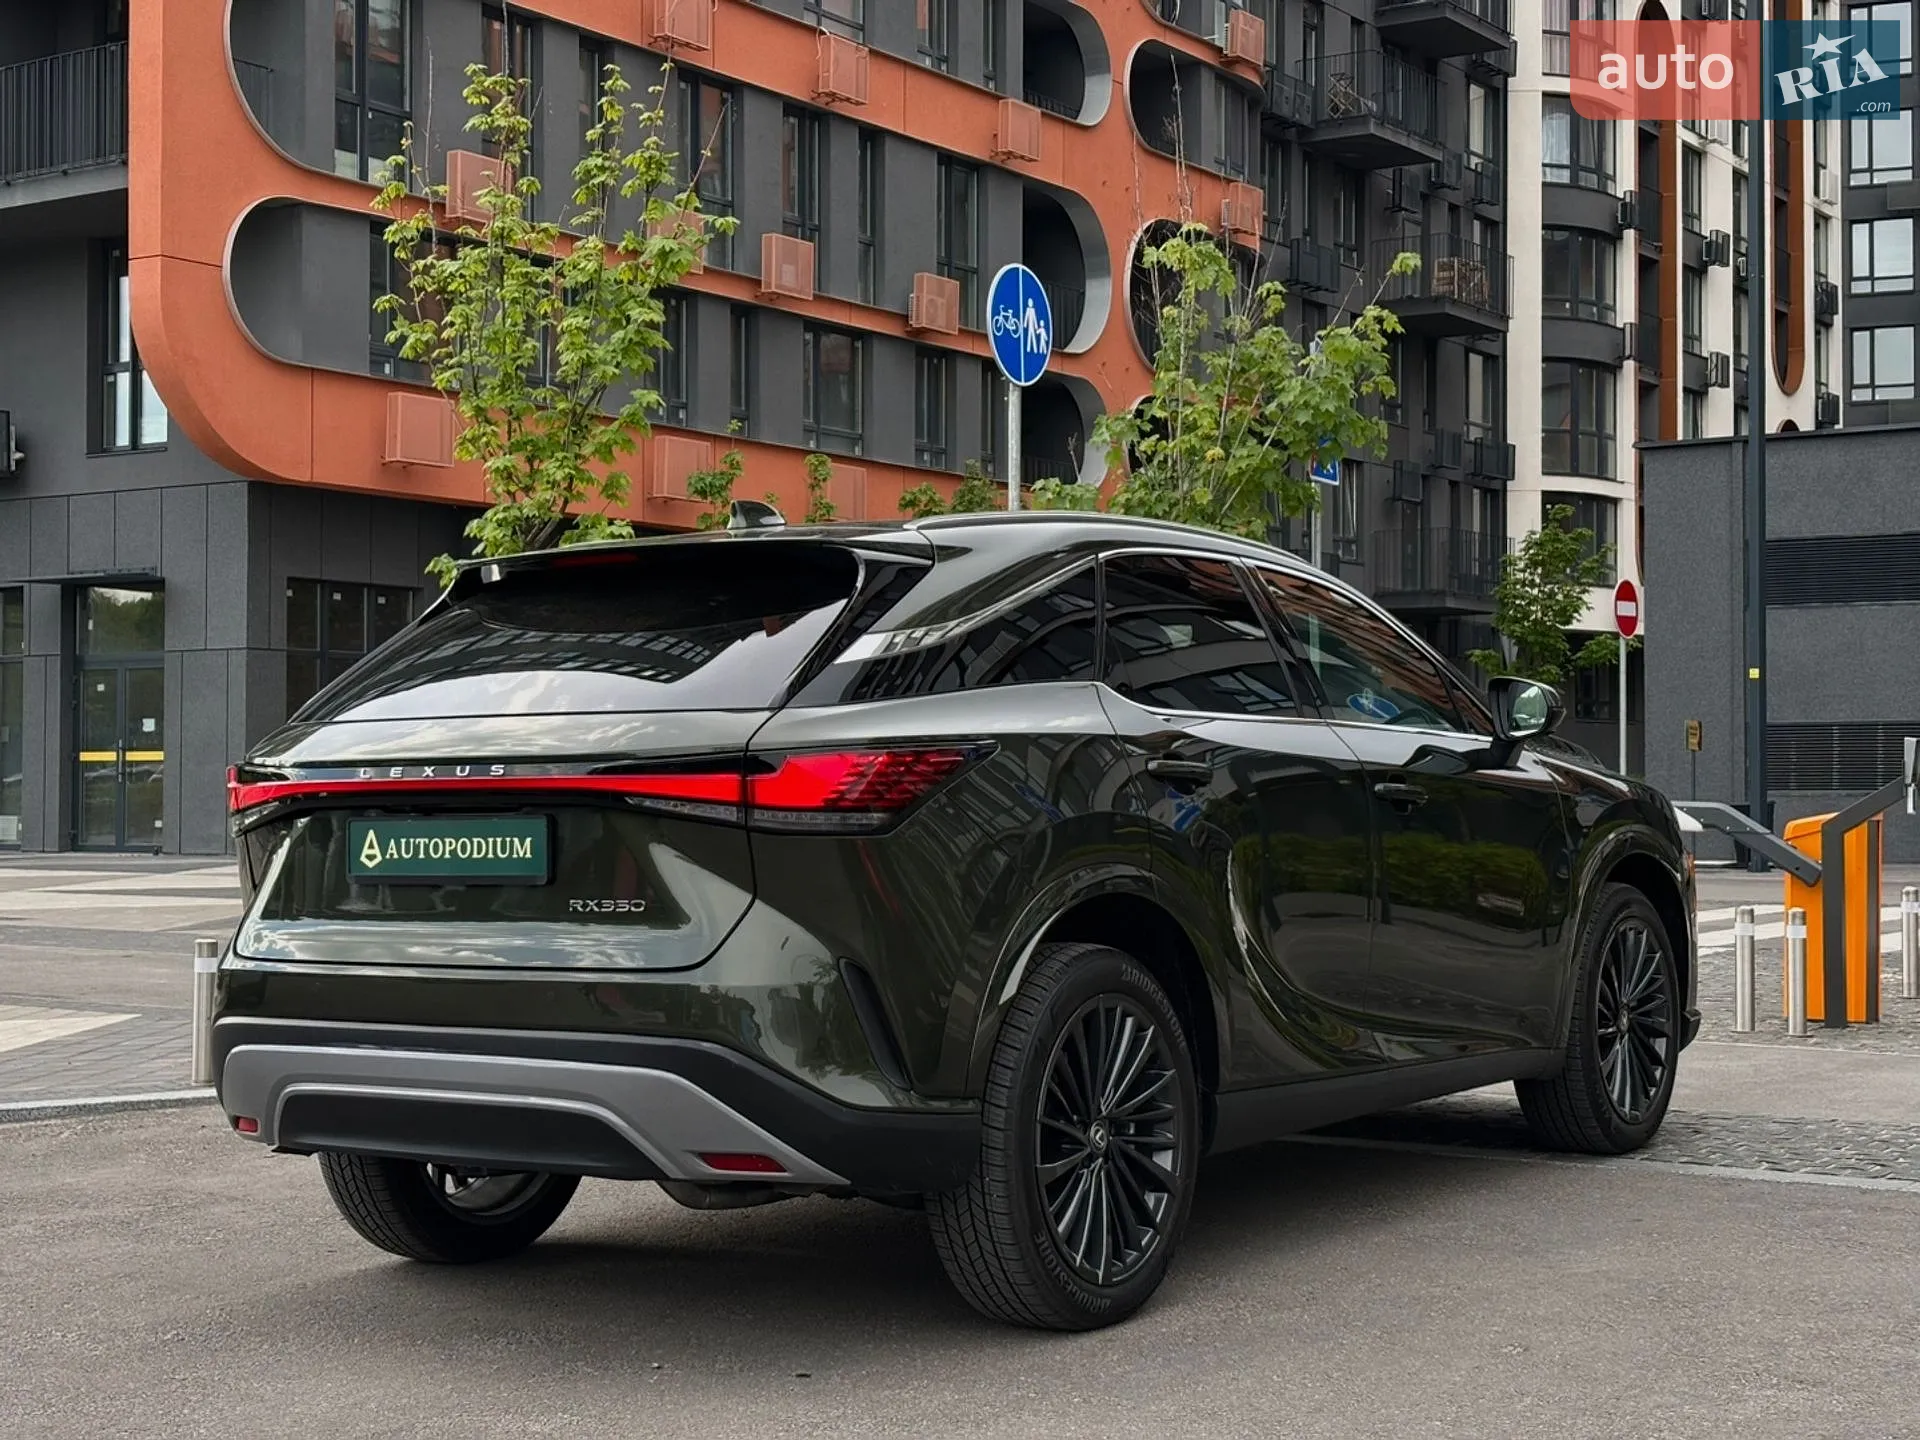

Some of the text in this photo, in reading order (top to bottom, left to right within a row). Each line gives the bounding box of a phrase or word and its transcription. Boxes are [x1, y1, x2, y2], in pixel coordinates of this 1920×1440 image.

[359, 765, 505, 779] LEXUS
[385, 837, 533, 859] AUTOPODIUM
[568, 899, 647, 913] RX350
